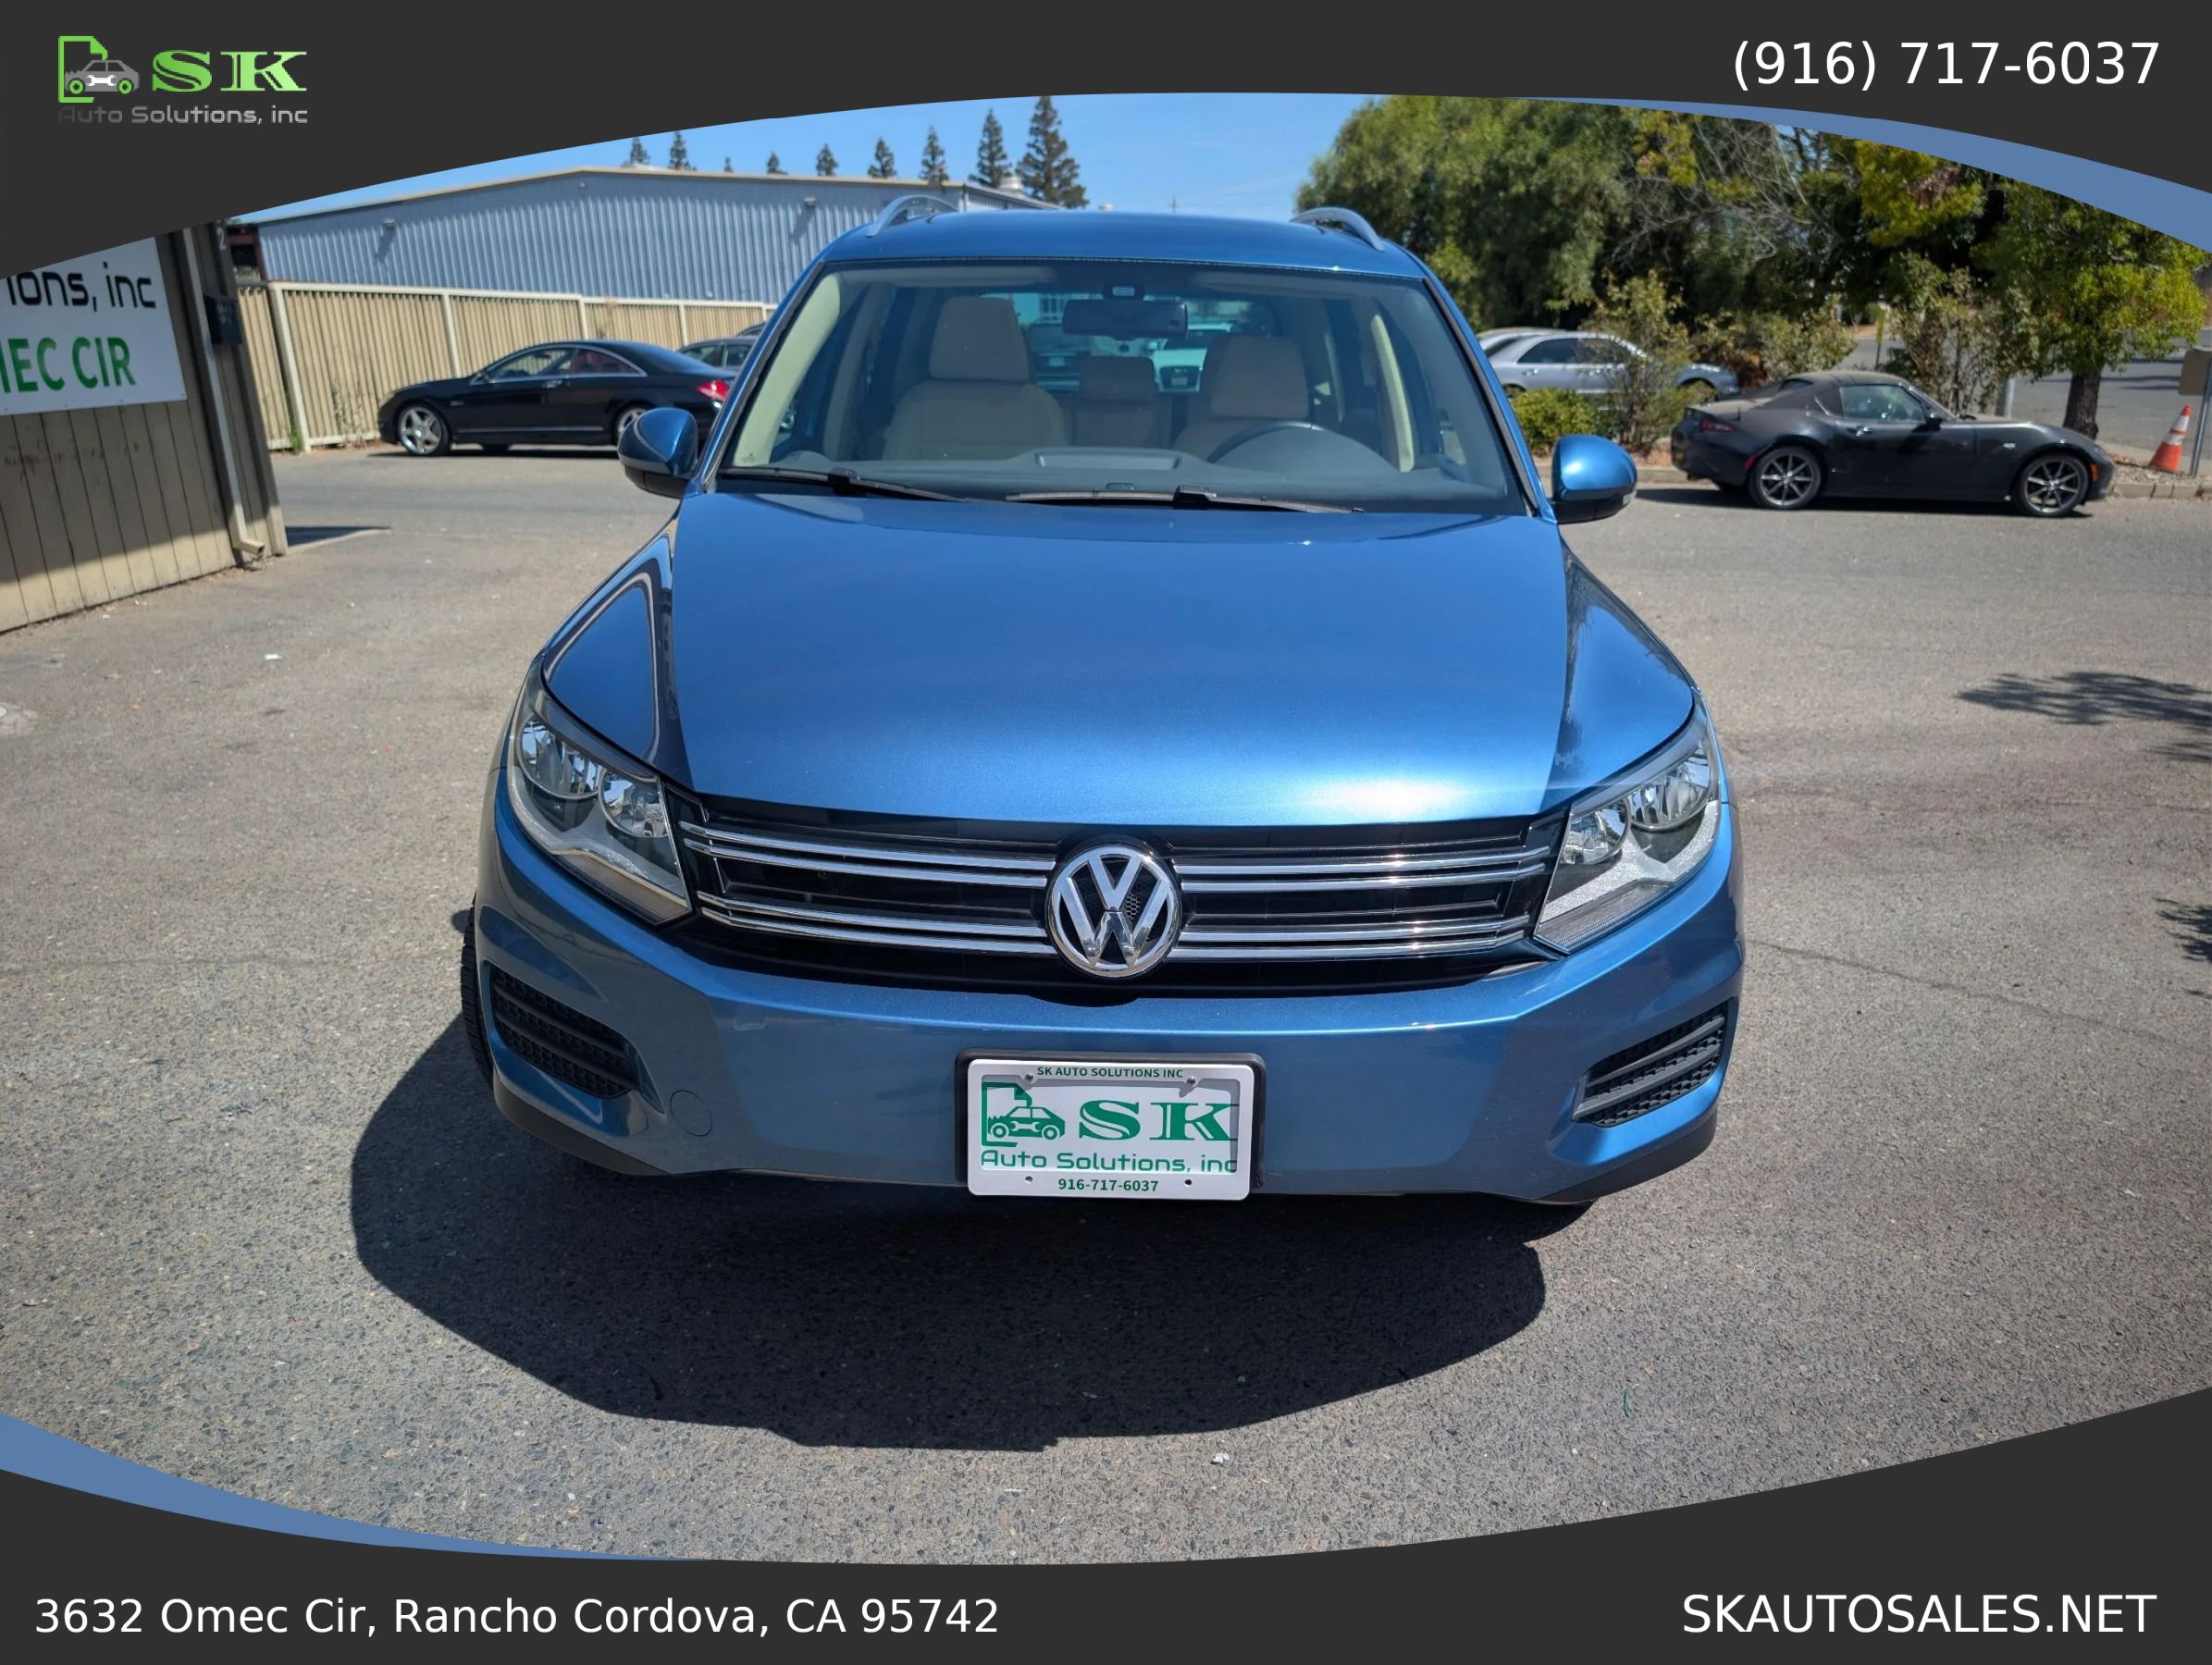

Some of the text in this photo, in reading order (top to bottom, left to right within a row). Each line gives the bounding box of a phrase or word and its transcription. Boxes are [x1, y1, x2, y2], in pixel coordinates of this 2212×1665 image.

[104, 261, 156, 309] inc
[72, 337, 137, 389] CIR
[1037, 1067, 1183, 1079] SK AUTO SOLUTIONS INC
[1079, 1099, 1239, 1141] SK
[981, 1150, 1237, 1173] Auto Solutions, inc
[1057, 1178, 1159, 1192] 916-717-6037
